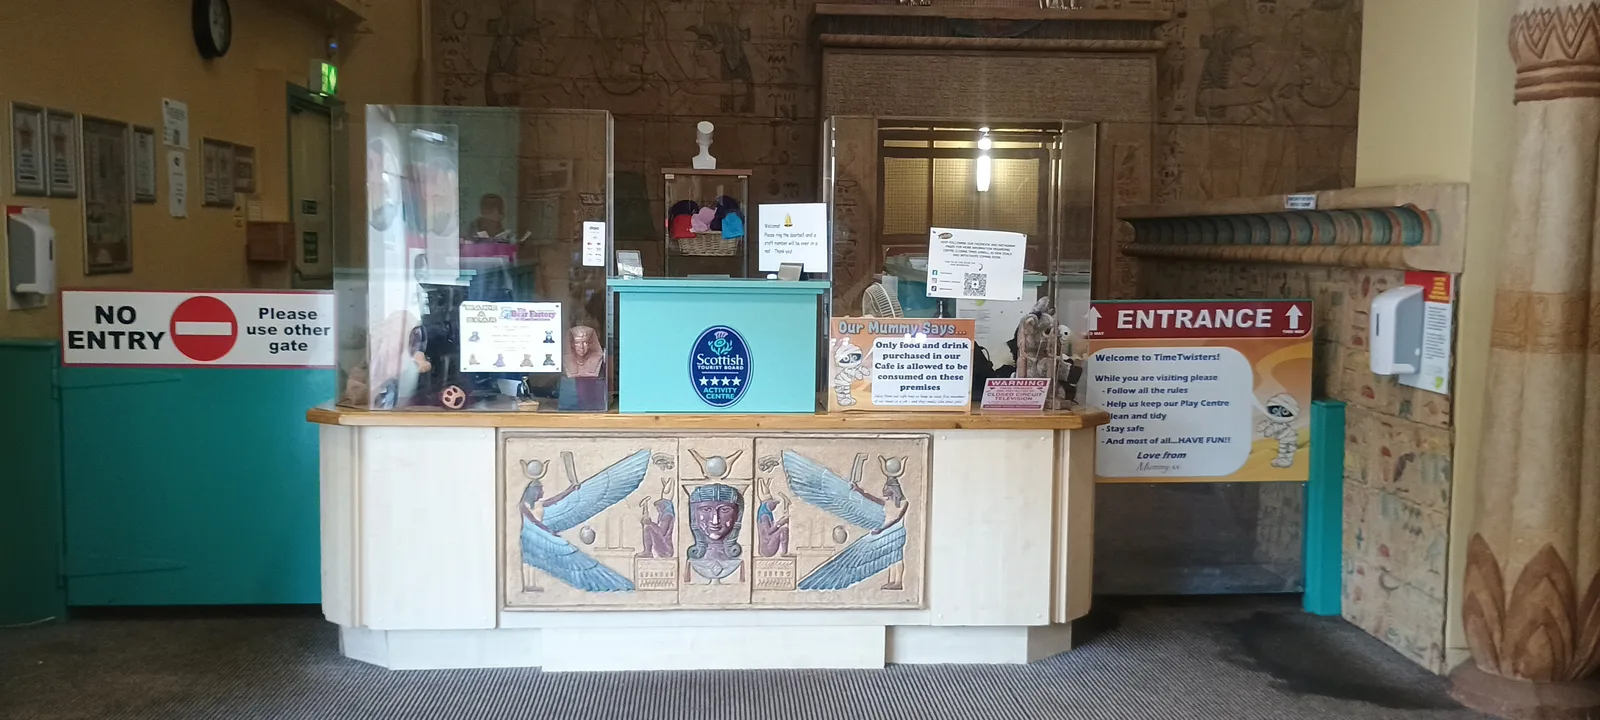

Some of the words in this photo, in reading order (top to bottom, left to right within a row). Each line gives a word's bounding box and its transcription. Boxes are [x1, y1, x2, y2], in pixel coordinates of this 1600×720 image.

[95, 305, 137, 325] NO
[259, 307, 318, 320] Please
[1117, 308, 1273, 330] ENTRANCE
[246, 325, 278, 336] use
[284, 324, 331, 336] other
[838, 321, 864, 335] Our
[867, 321, 919, 337] Mummy
[68, 330, 166, 350] ENTRY
[269, 339, 308, 354] gate
[875, 342, 897, 351] Only
[696, 353, 745, 366] Scottish
[882, 352, 929, 361] purchased
[1095, 354, 1139, 362] Welcome
[1154, 353, 1220, 362] TimeTwisters!
[1156, 374, 1189, 384] visiting
[1190, 374, 1218, 384] please
[899, 384, 940, 392] premises
[1106, 399, 1126, 409] Help
[1140, 399, 1163, 409] keep
[1180, 399, 1198, 409] Play
[1150, 412, 1167, 422] tidy
[1106, 425, 1124, 434] Stay
[1136, 451, 1161, 460] Love
[1163, 451, 1186, 460] from
[1136, 462, 1172, 474] Mummy
